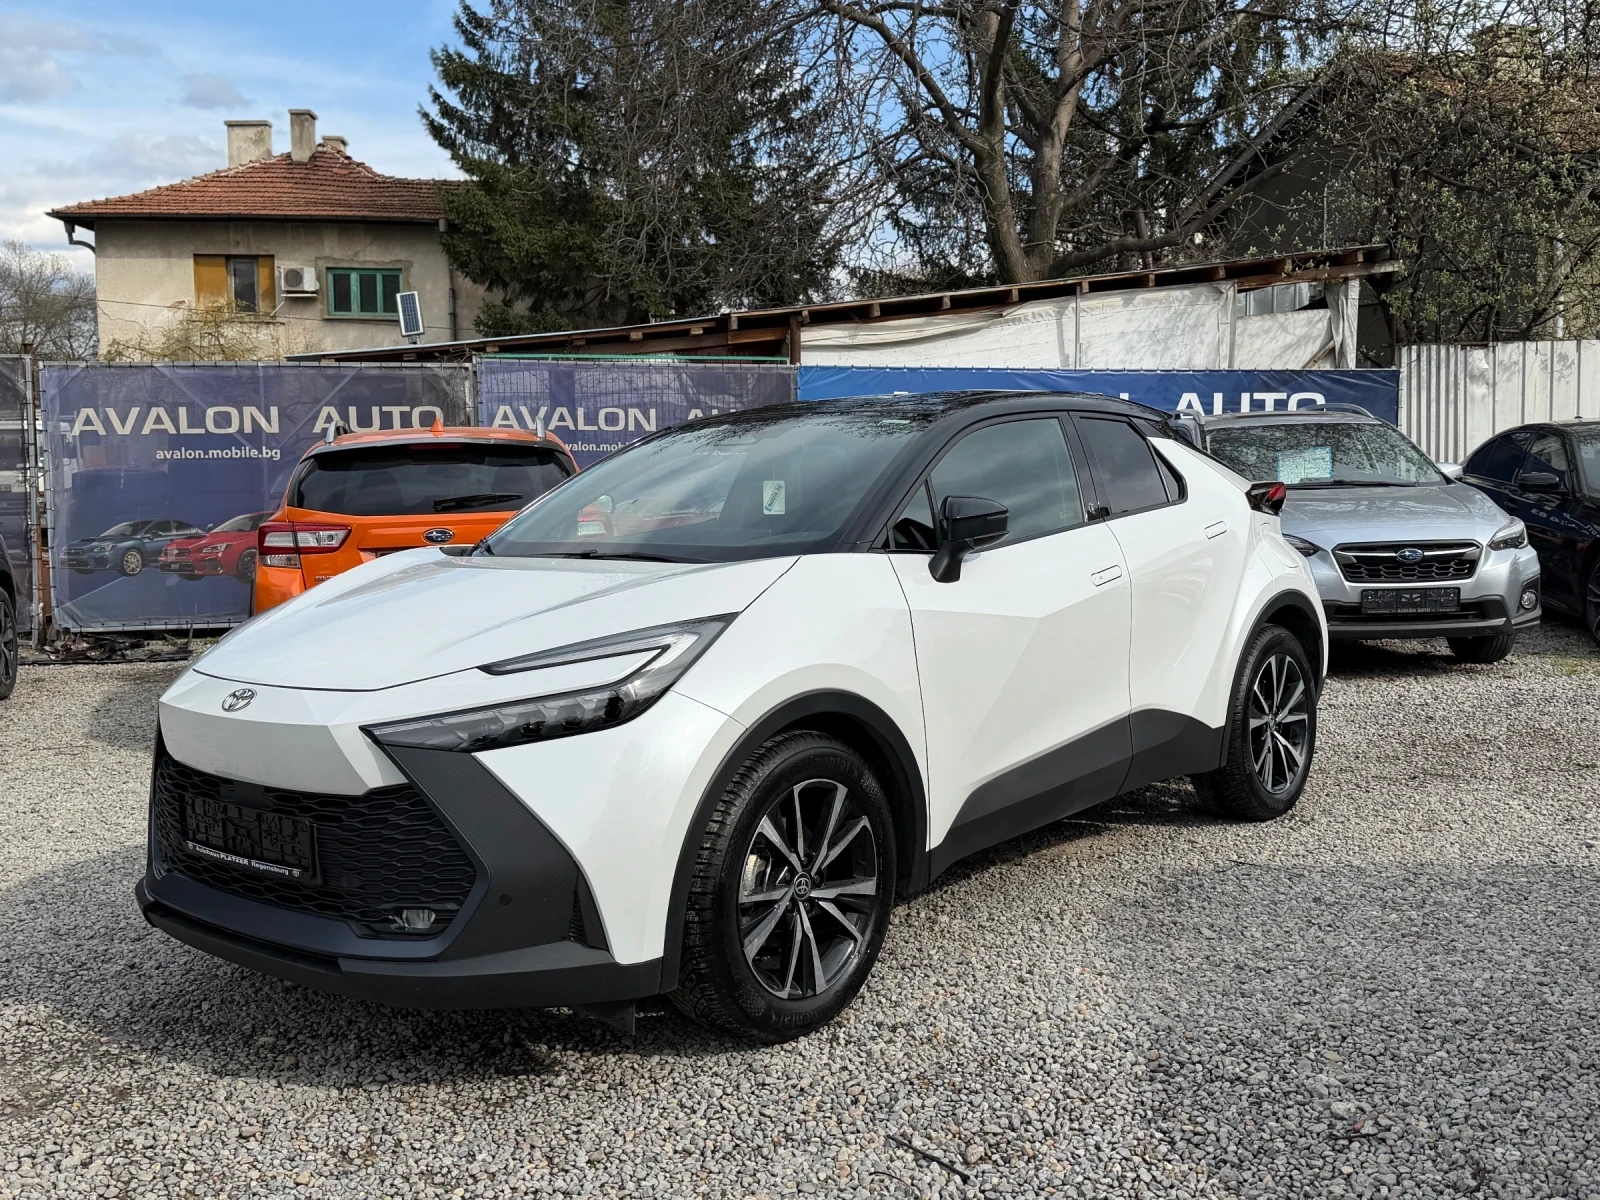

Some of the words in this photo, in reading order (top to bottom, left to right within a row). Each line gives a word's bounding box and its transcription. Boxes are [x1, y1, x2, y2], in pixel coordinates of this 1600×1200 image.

[493, 405, 656, 432] AVALON
[1176, 392, 1326, 418] AUTO
[71, 406, 280, 436] AVALON
[312, 405, 444, 432] AUTO
[155, 446, 281, 461] avalon.mobile.bg
[786, 754, 852, 781] Ctinental
[196, 846, 219, 858] Autohaus
[220, 853, 249, 865] PLATZER
[251, 861, 289, 876] Regensburg
